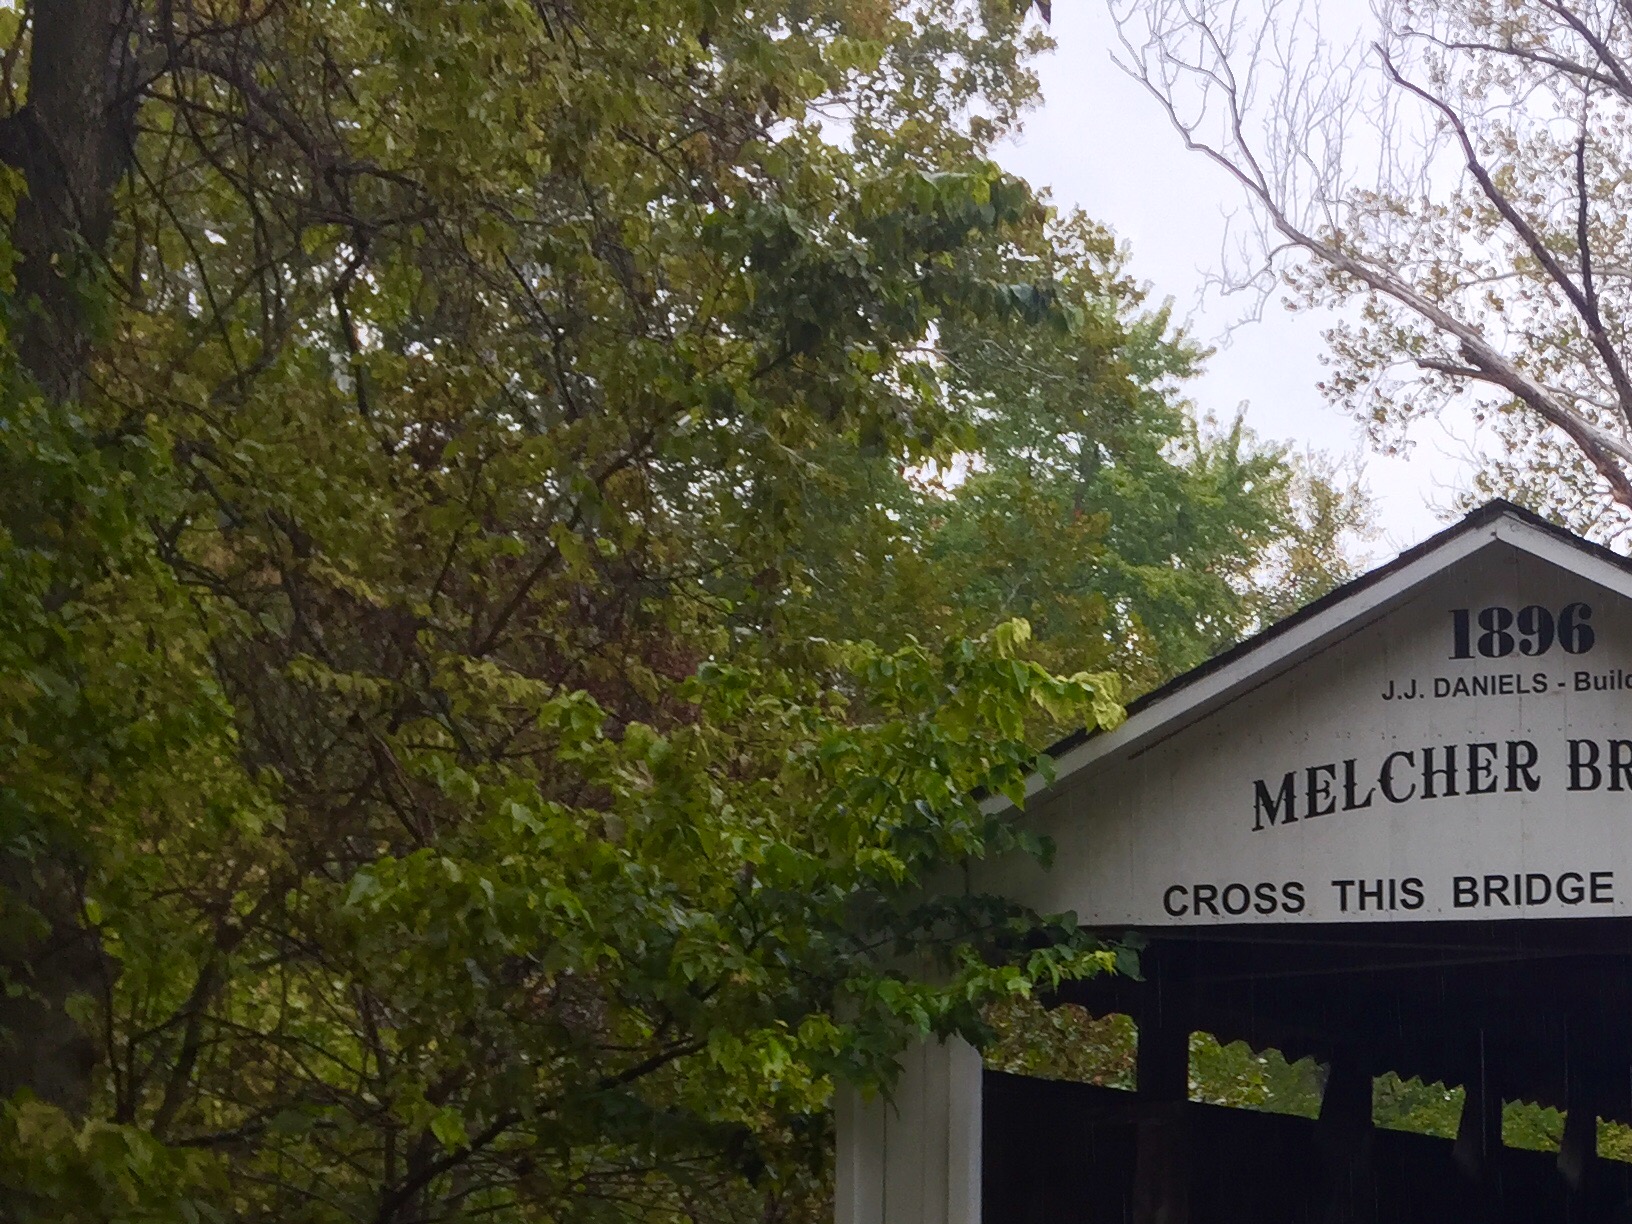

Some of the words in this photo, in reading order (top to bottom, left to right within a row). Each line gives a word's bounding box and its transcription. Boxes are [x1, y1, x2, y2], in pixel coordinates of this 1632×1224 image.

[1448, 602, 1596, 660] 1896
[1381, 679, 1425, 701] J.J.
[1433, 672, 1549, 698] DANIELS
[1251, 739, 1541, 832] MELCHER
[1162, 881, 1306, 917] CROSS
[1331, 877, 1425, 912] THIS
[1452, 871, 1615, 908] BRIDGE
